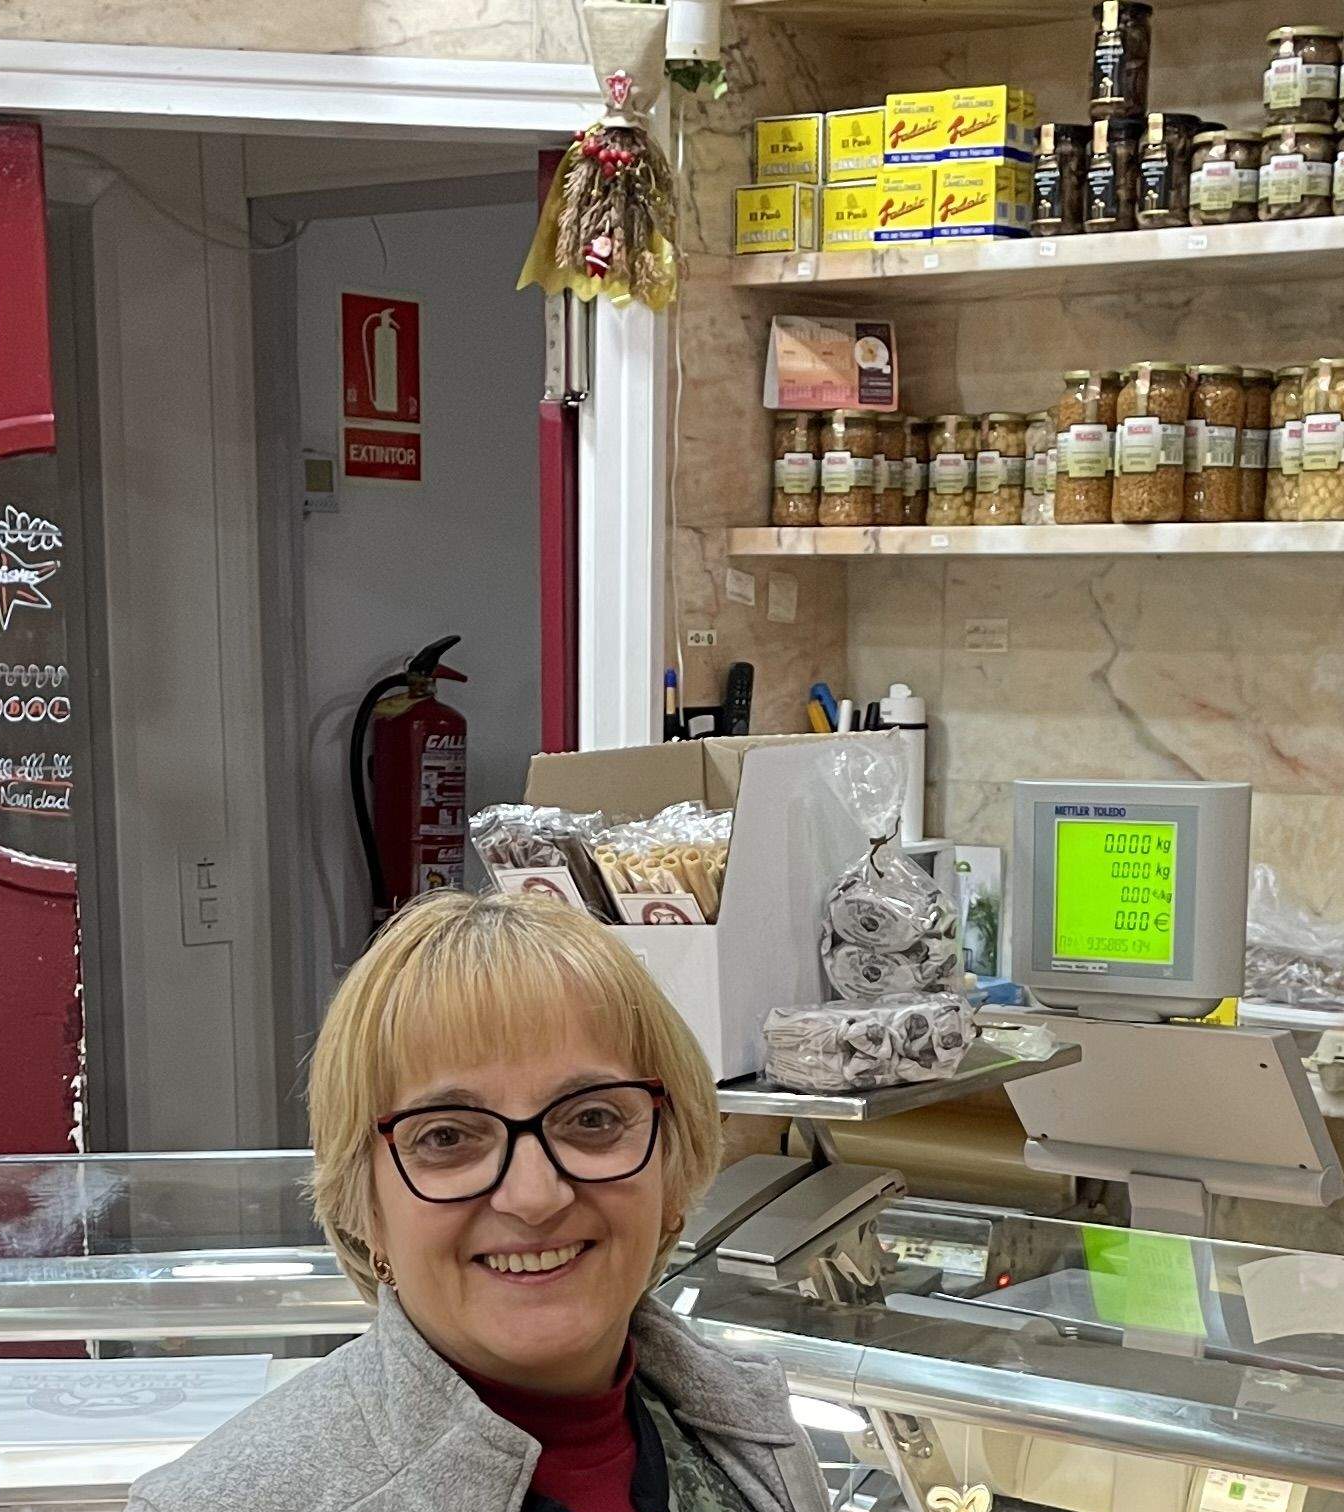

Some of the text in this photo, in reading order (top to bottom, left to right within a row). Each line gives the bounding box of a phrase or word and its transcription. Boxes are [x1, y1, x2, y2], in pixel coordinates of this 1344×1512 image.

[348, 443, 417, 467] EXTINTOR
[0, 781, 71, 811] Navidad
[1055, 805, 1127, 818] METTLER TOLEDO
[1156, 836, 1172, 853] kg
[1155, 863, 1170, 880] kg
[1153, 912, 1171, 932] €
